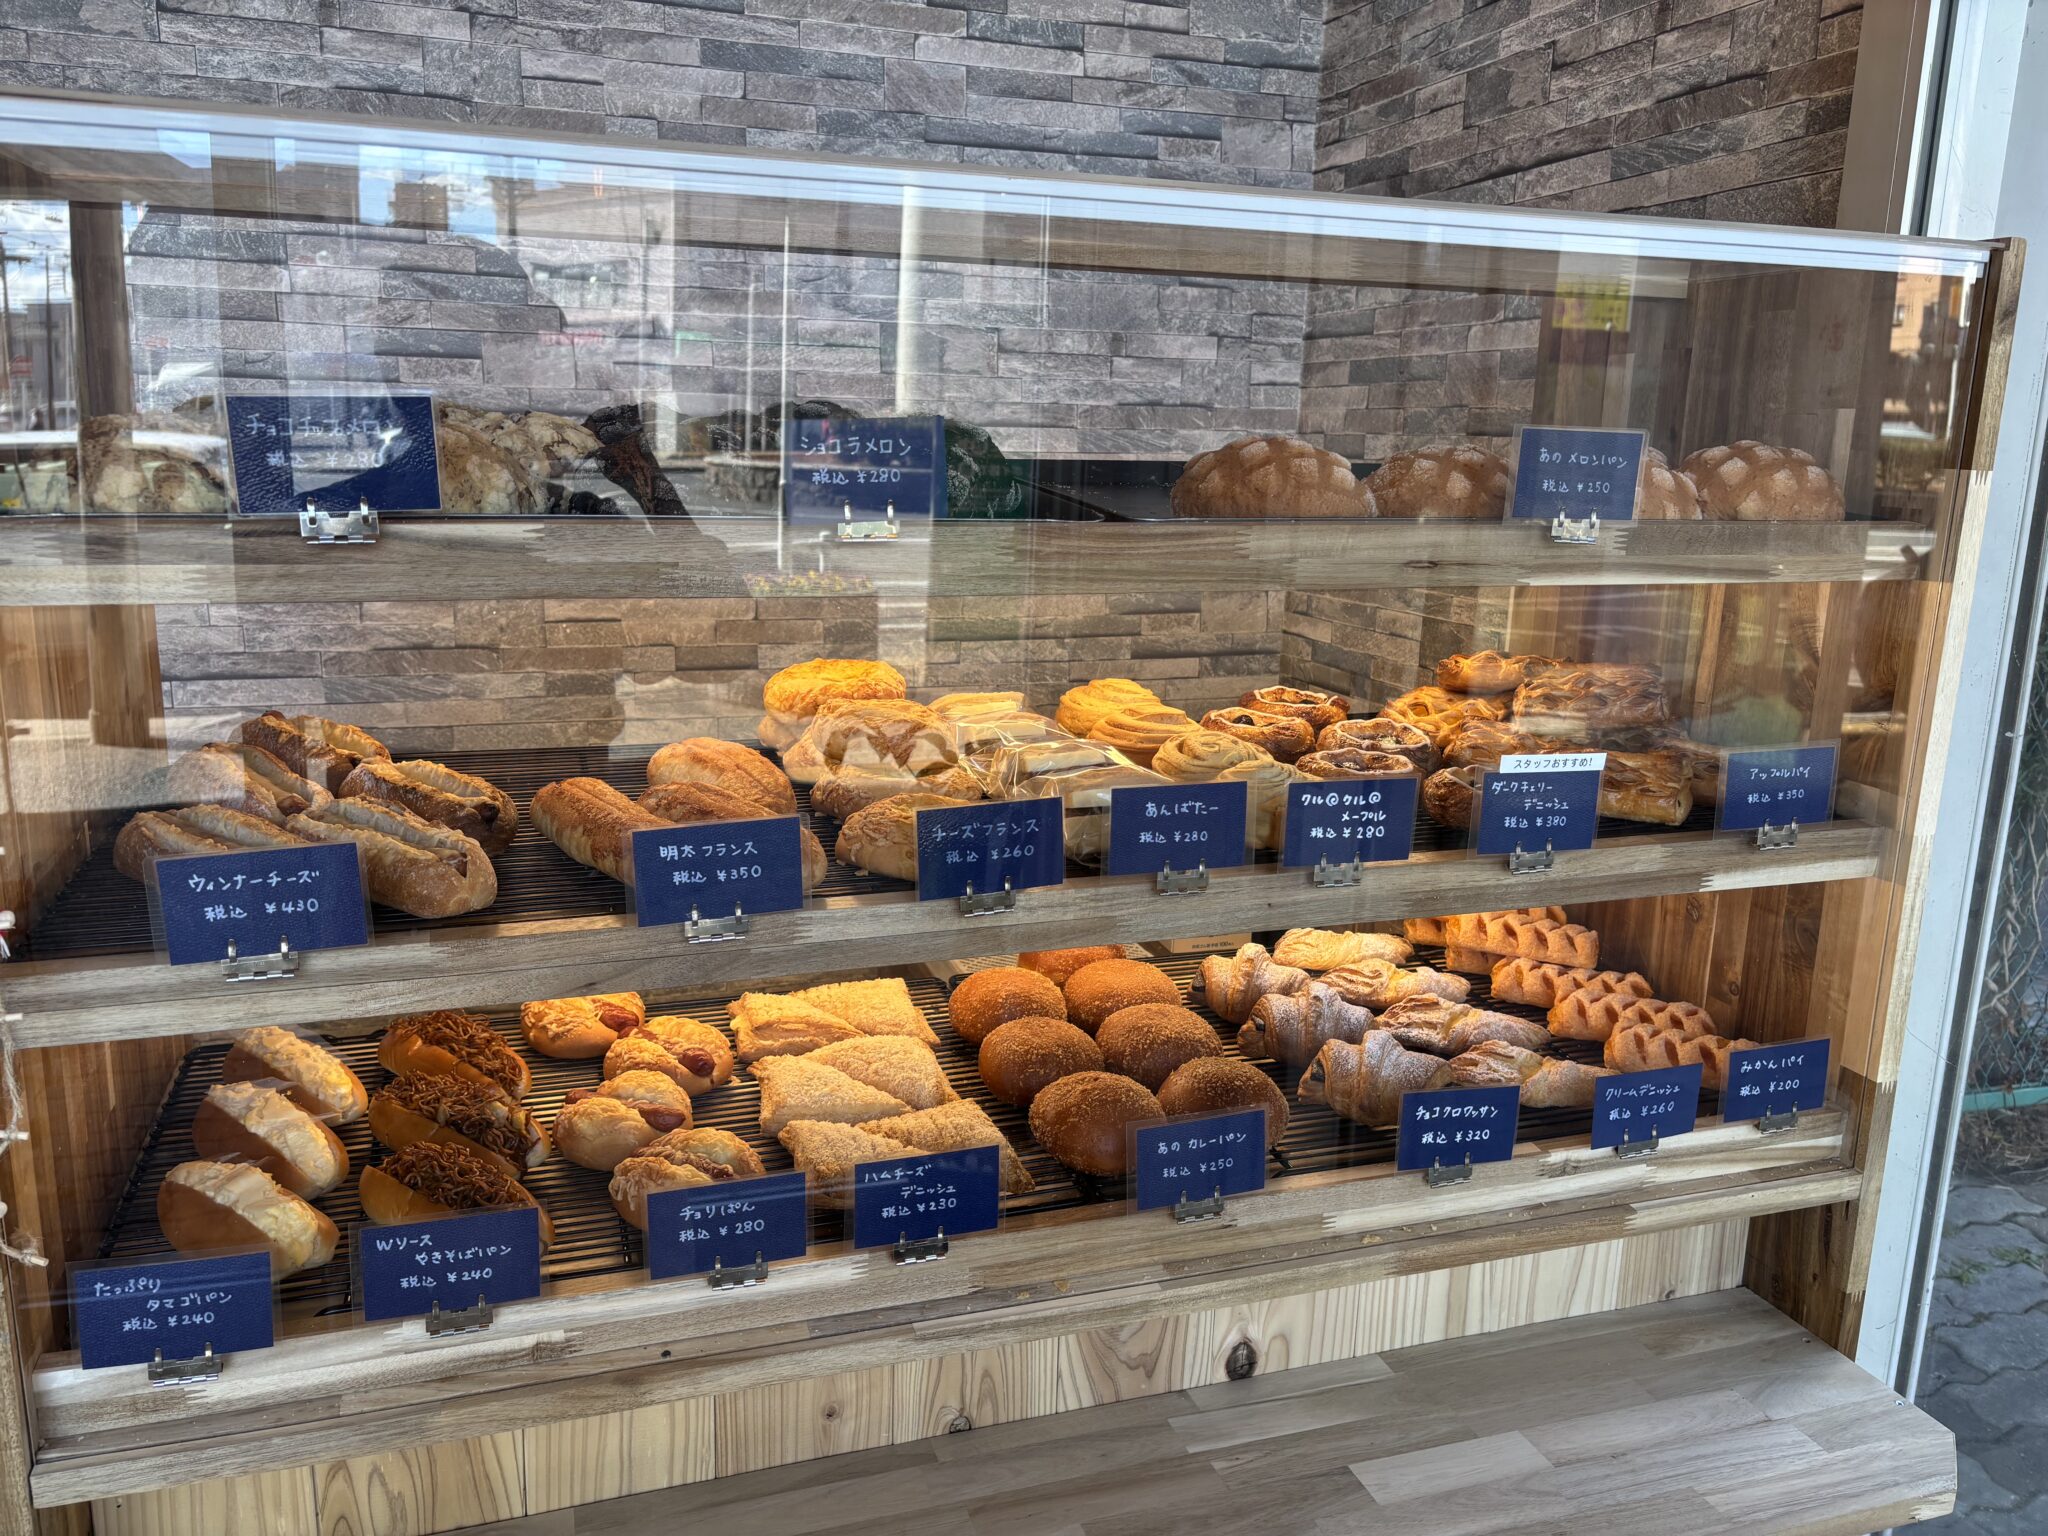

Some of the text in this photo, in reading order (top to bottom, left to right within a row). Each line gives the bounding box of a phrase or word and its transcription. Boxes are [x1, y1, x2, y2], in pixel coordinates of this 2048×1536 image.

[800, 436, 911, 456] ショコラメロン
[1540, 447, 1628, 469] あの メロンパン
[812, 467, 900, 485] 税込 ¥280
[1542, 479, 1610, 493] 税込 ¥250
[1750, 766, 1811, 780] アップルパイ
[1491, 781, 1553, 795] ダークチェリー
[1747, 789, 1805, 804] 税込 ¥350
[1145, 801, 1219, 818] あんばたー
[1524, 798, 1569, 811] デニッシュ
[1341, 810, 1387, 822] メープル
[1504, 816, 1567, 828] 税込 ¥380
[932, 818, 1039, 842] チーズフランス
[1139, 830, 1208, 844] 税込 ¥280
[1310, 825, 1385, 838] 税込 ¥280
[945, 844, 1035, 864] 税込 ¥260
[188, 870, 319, 892] ウィンナーチーズ
[672, 865, 762, 885] 税込 ¥350
[204, 898, 319, 922] 税込 ¥430
[1605, 1083, 1680, 1101] クリームデニッシュ
[1739, 1079, 1800, 1097] 税込 ¥200
[1415, 1105, 1499, 1121] チョコクロワッサン
[1609, 1101, 1675, 1121] 税込 ¥260
[1157, 1132, 1246, 1155] あの カレーパン
[1421, 1129, 1490, 1144] 税込 ¥320
[864, 1163, 932, 1183] ハムチーズ
[1162, 1158, 1234, 1178] 税込 ¥250
[900, 1183, 957, 1199] デニッシュ
[679, 1202, 755, 1221] チョリぱん
[881, 1198, 957, 1219] 税込 ¥230
[678, 1219, 765, 1242] 税込 ¥280
[375, 1234, 433, 1251] Wソース
[415, 1245, 511, 1266] やきそばパン
[94, 1277, 161, 1297] たっぷり
[400, 1267, 493, 1289] 税込 ¥240
[147, 1291, 232, 1312] タマゴパン
[122, 1311, 215, 1332] 税込 ¥240
